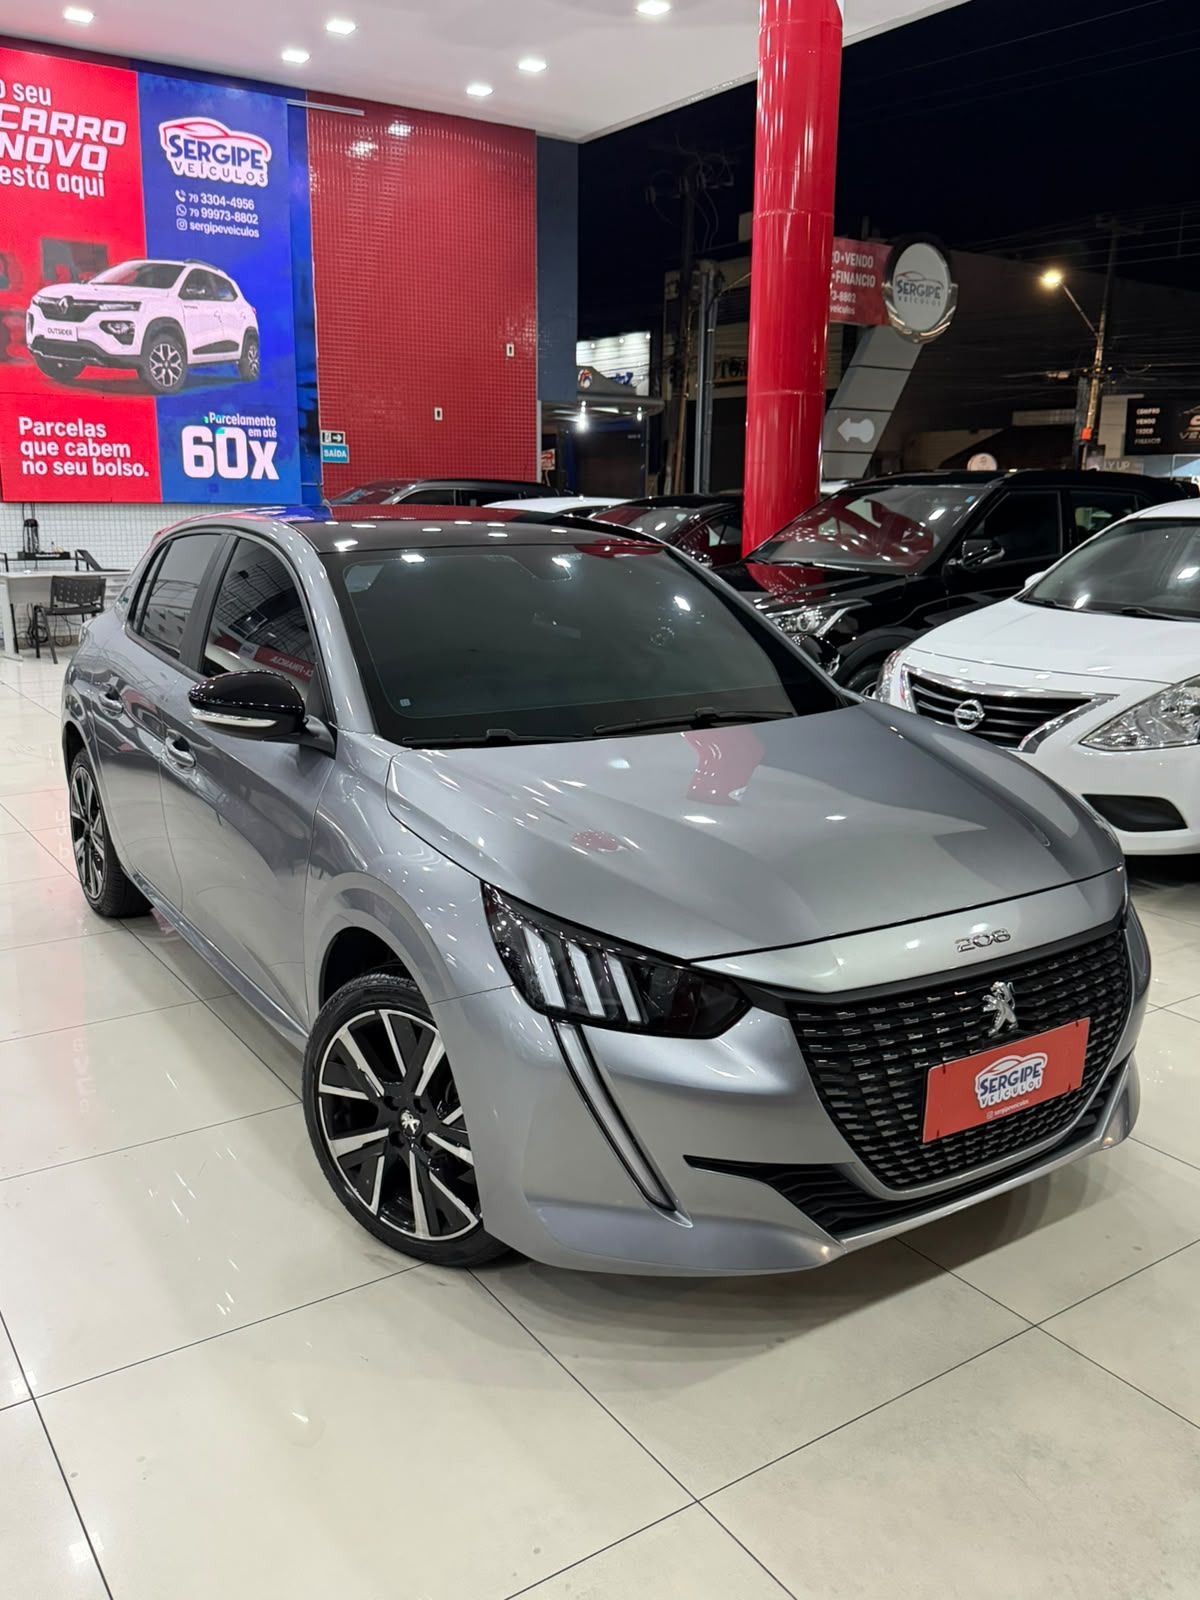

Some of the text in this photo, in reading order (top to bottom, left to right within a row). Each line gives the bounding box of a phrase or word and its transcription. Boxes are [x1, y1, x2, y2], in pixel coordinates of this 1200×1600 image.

[12, 82, 51, 106] seu
[0, 103, 127, 146] CARRO
[0, 131, 108, 171] NOVO
[168, 134, 264, 170] SERGIPE
[0, 164, 105, 200] está aqui
[174, 161, 265, 183] VEÍCULOS
[188, 192, 255, 210] 79 3304-4956
[189, 207, 259, 225] 79 99973-8802
[189, 221, 260, 238] sergipeveiculos
[897, 279, 942, 299] SERGIPE
[18, 416, 107, 438] Parcelas
[208, 412, 277, 427] Parcelamento
[248, 426, 277, 438] em até
[20, 438, 131, 459] que cabem
[323, 448, 347, 458] SAÍDA
[22, 457, 149, 477] no seu bolso.
[955, 928, 1011, 952] 208
[980, 1061, 1042, 1097] SERGIPE
